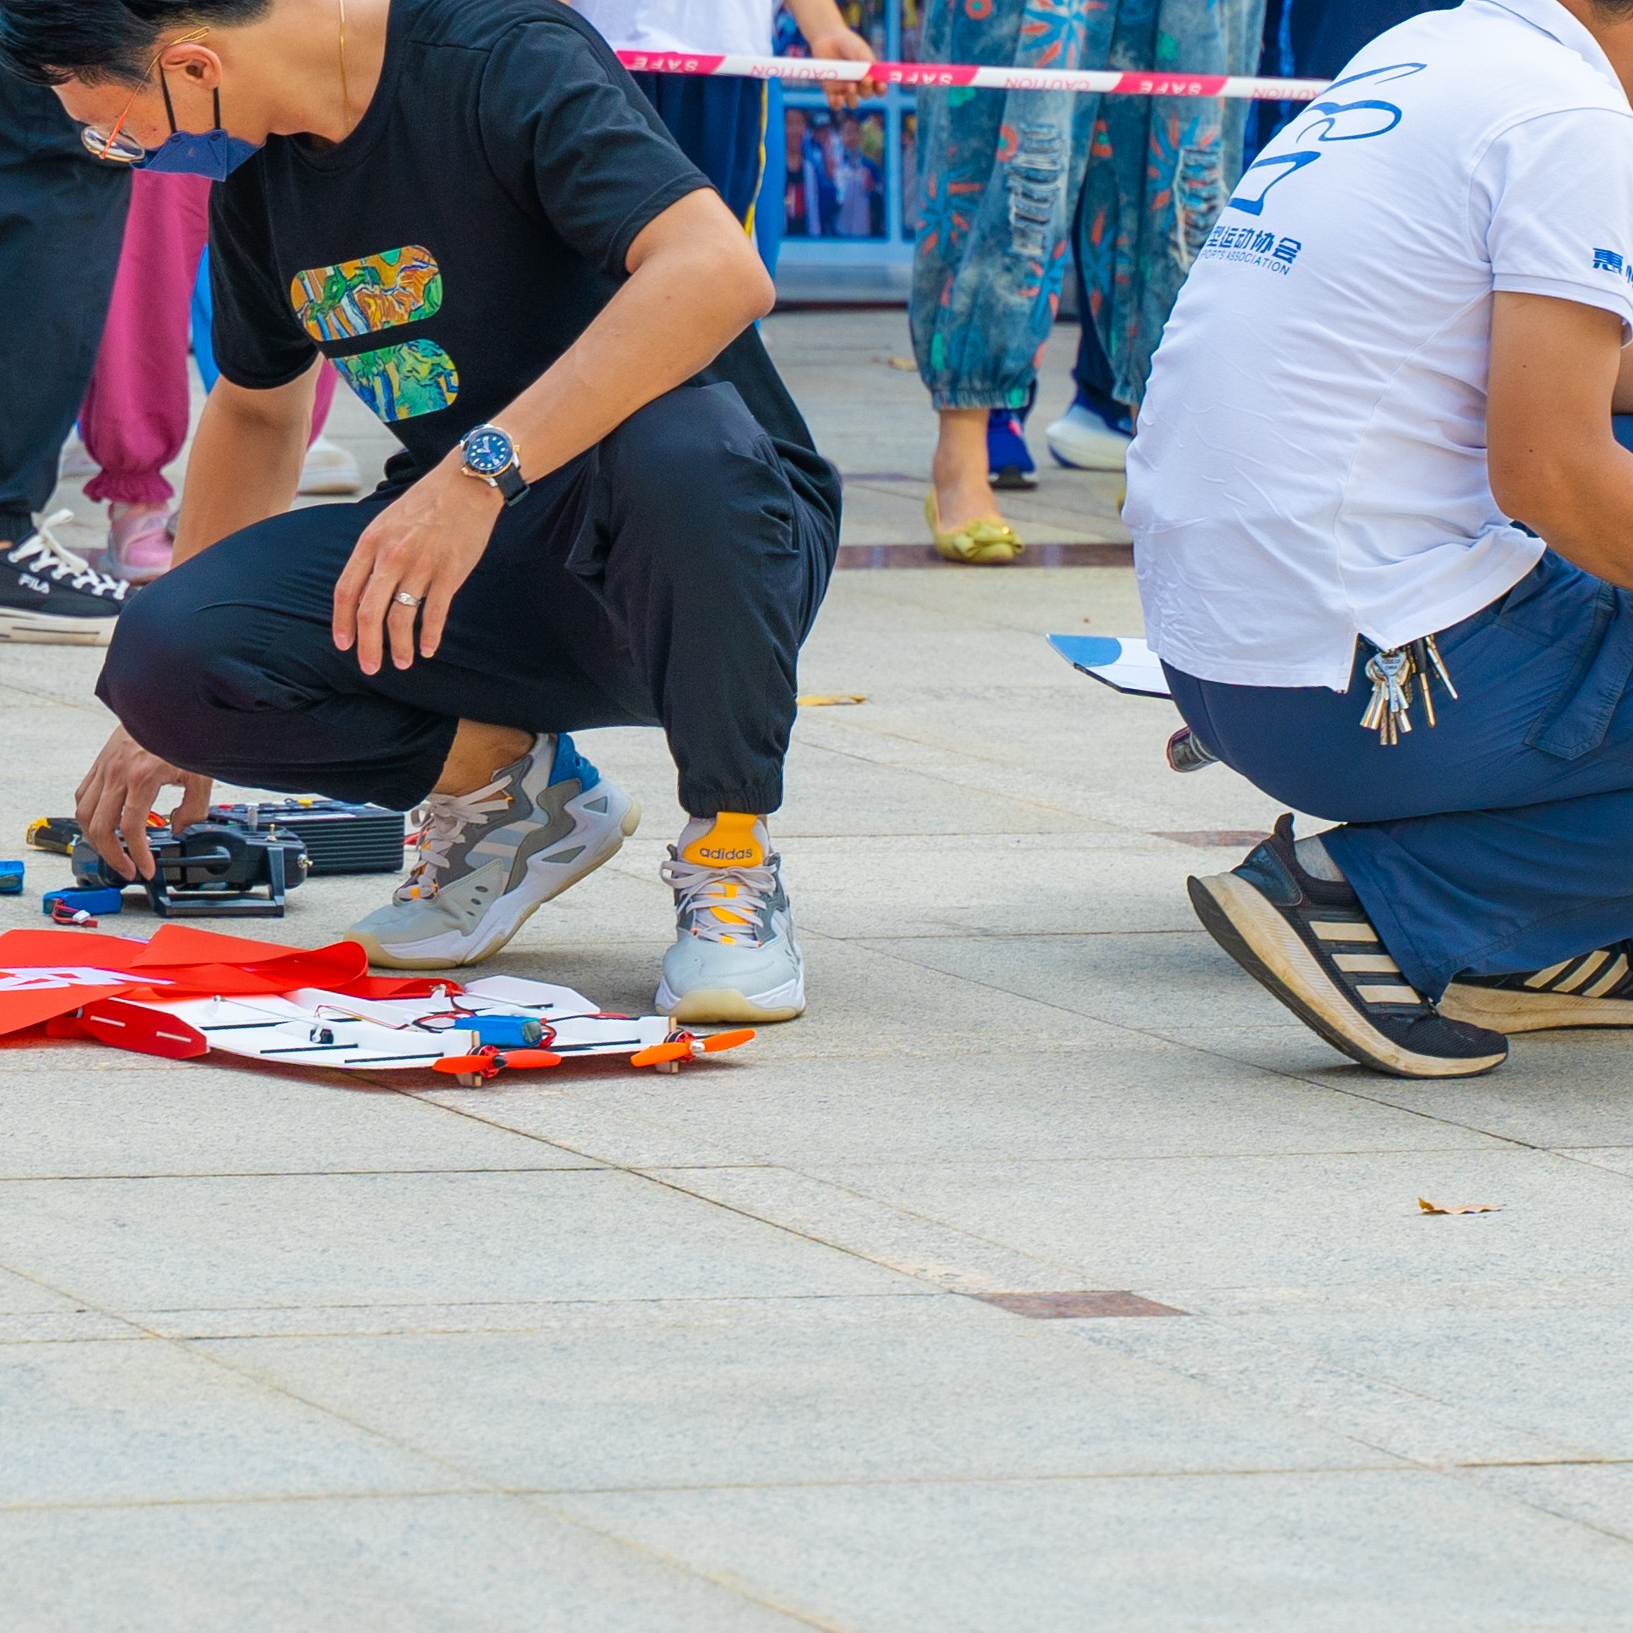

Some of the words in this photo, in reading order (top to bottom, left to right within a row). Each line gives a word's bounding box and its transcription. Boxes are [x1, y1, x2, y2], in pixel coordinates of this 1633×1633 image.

[633, 56, 700, 72] SAFE
[751, 64, 838, 81] CAUTION
[889, 70, 954, 86] SAFE
[1004, 77, 1090, 93] CAUTION
[1138, 80, 1203, 97] SAFE
[1253, 86, 1324, 101] AUTION
[1225, 250, 1291, 275] ASSOCIATION
[699, 847, 753, 860] adidas
